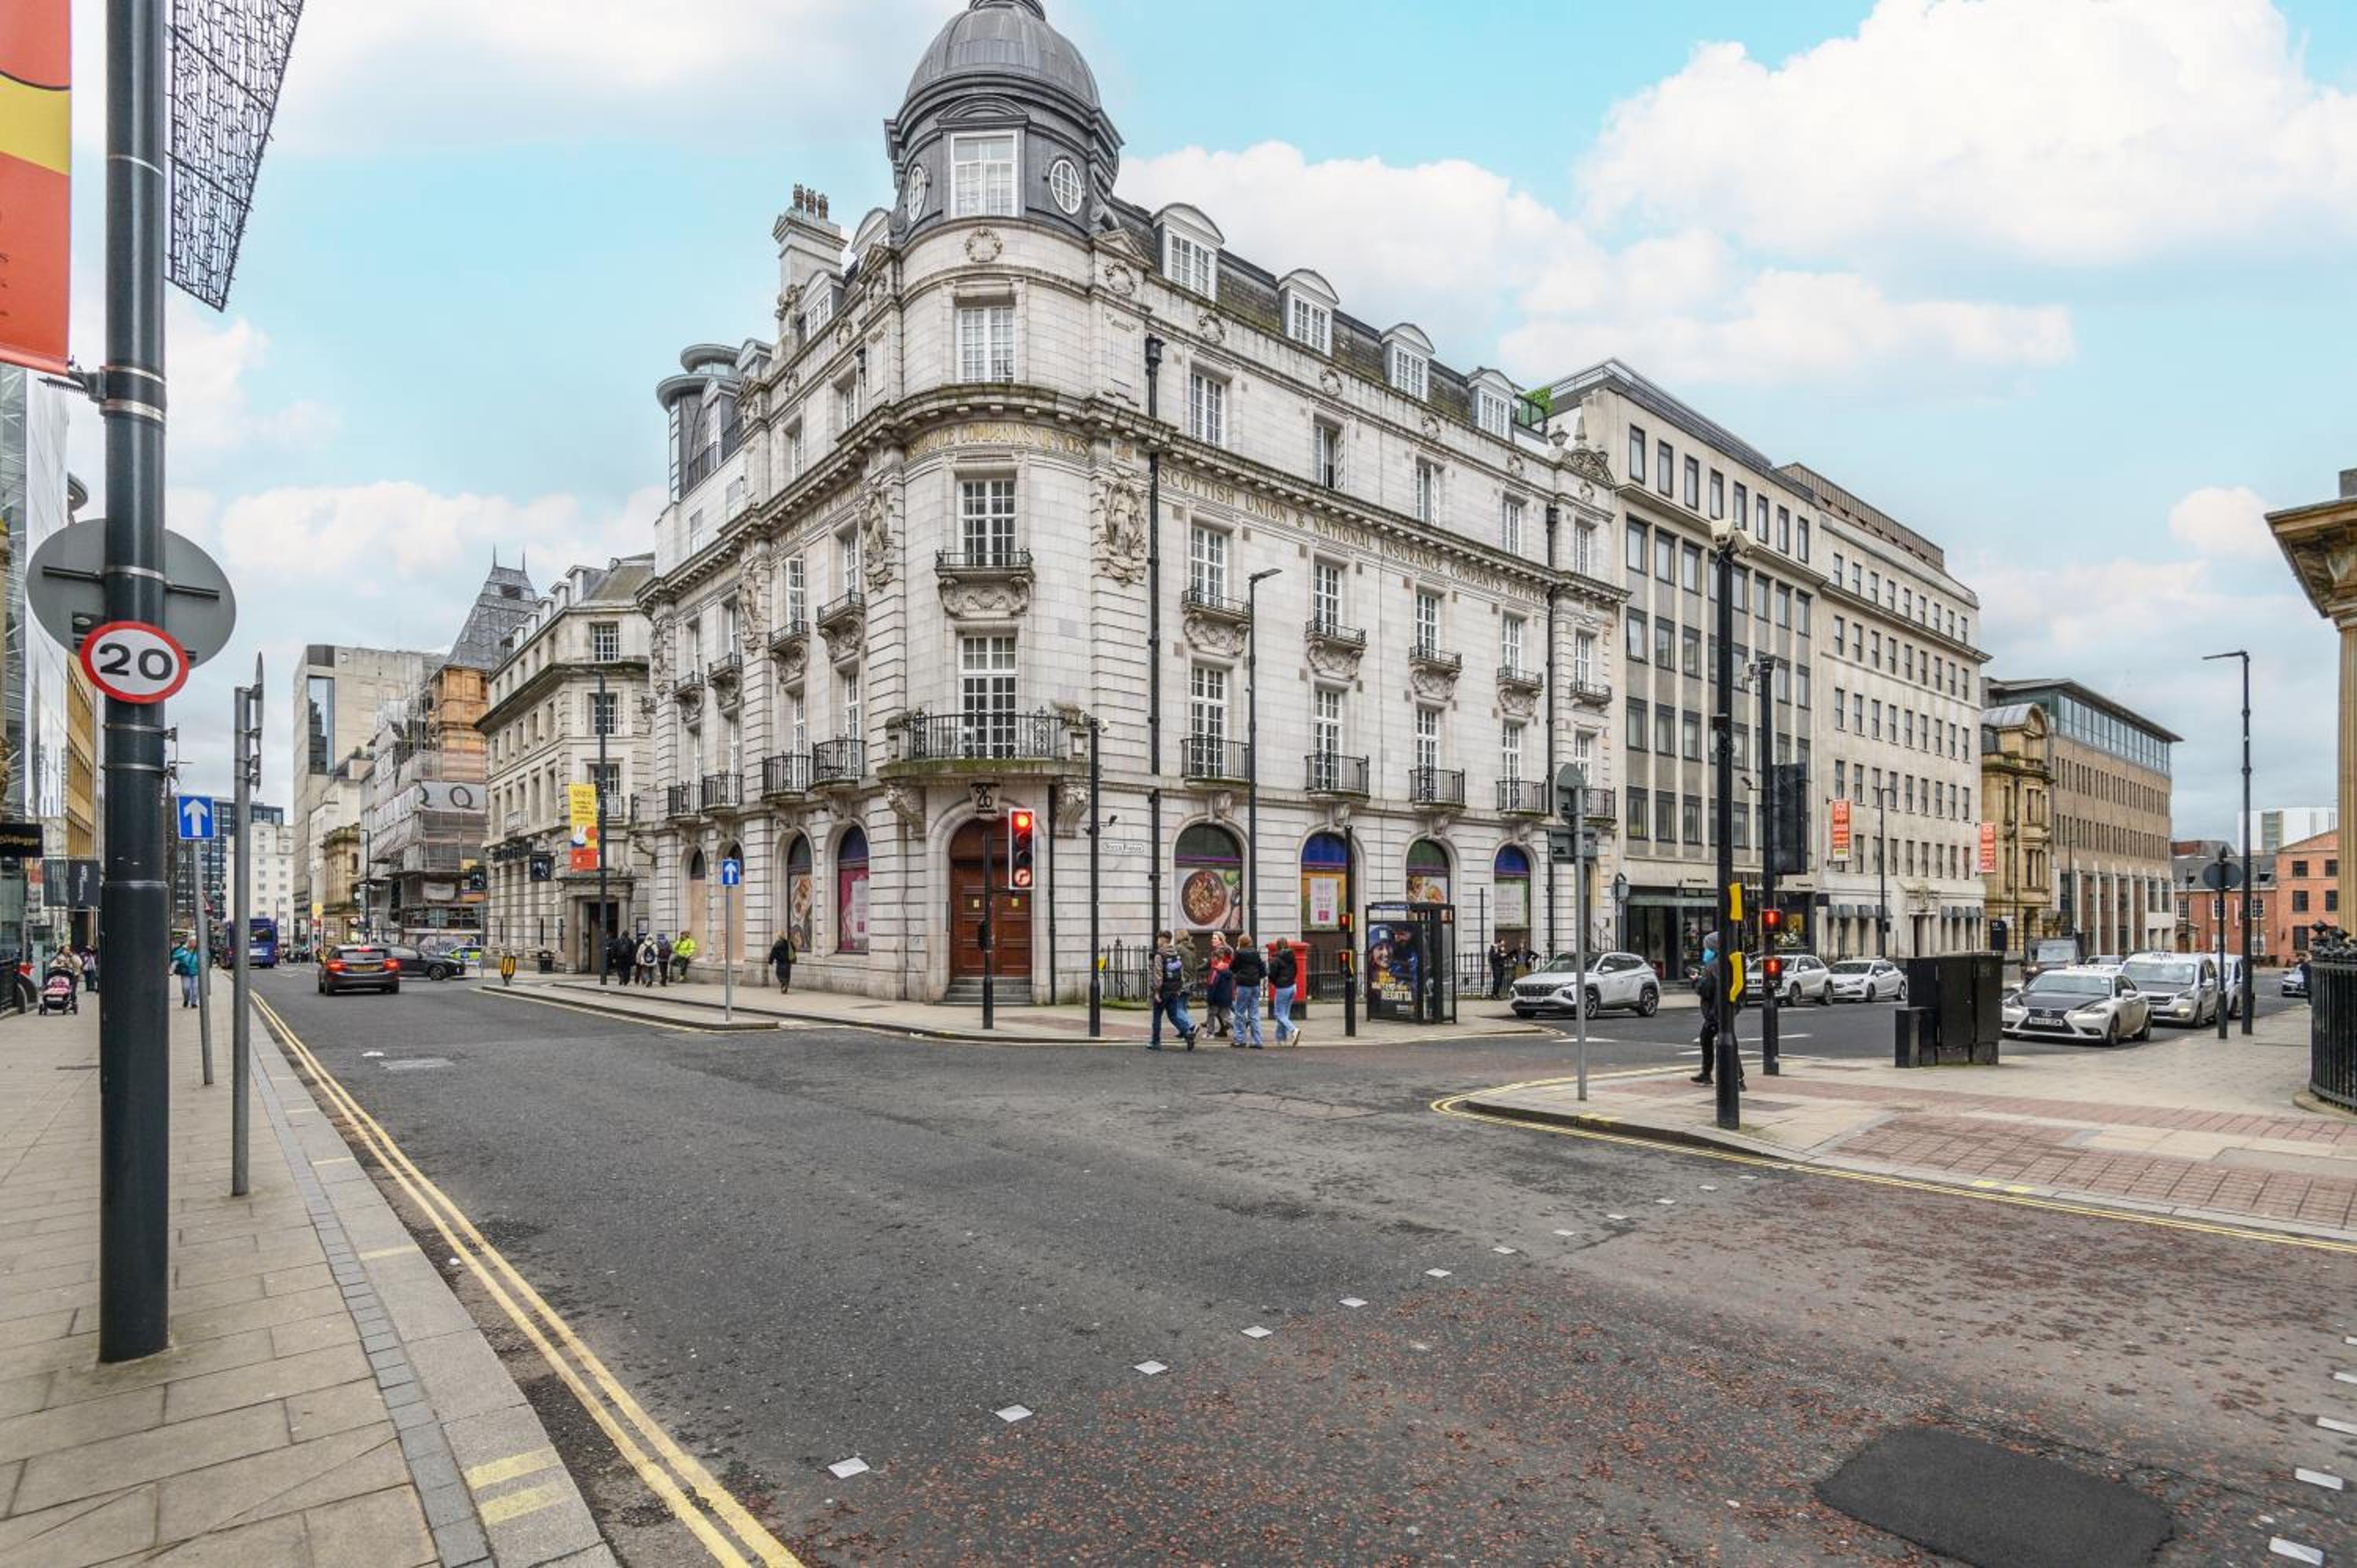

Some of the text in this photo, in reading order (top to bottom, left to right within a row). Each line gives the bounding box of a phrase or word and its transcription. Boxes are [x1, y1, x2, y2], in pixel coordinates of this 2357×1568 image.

[1159, 467, 1234, 506] SCOTTISH
[1245, 494, 1287, 523] UNION
[1296, 511, 1305, 528] &
[1314, 515, 1373, 550] NATIONAL
[99, 643, 173, 680] 20
